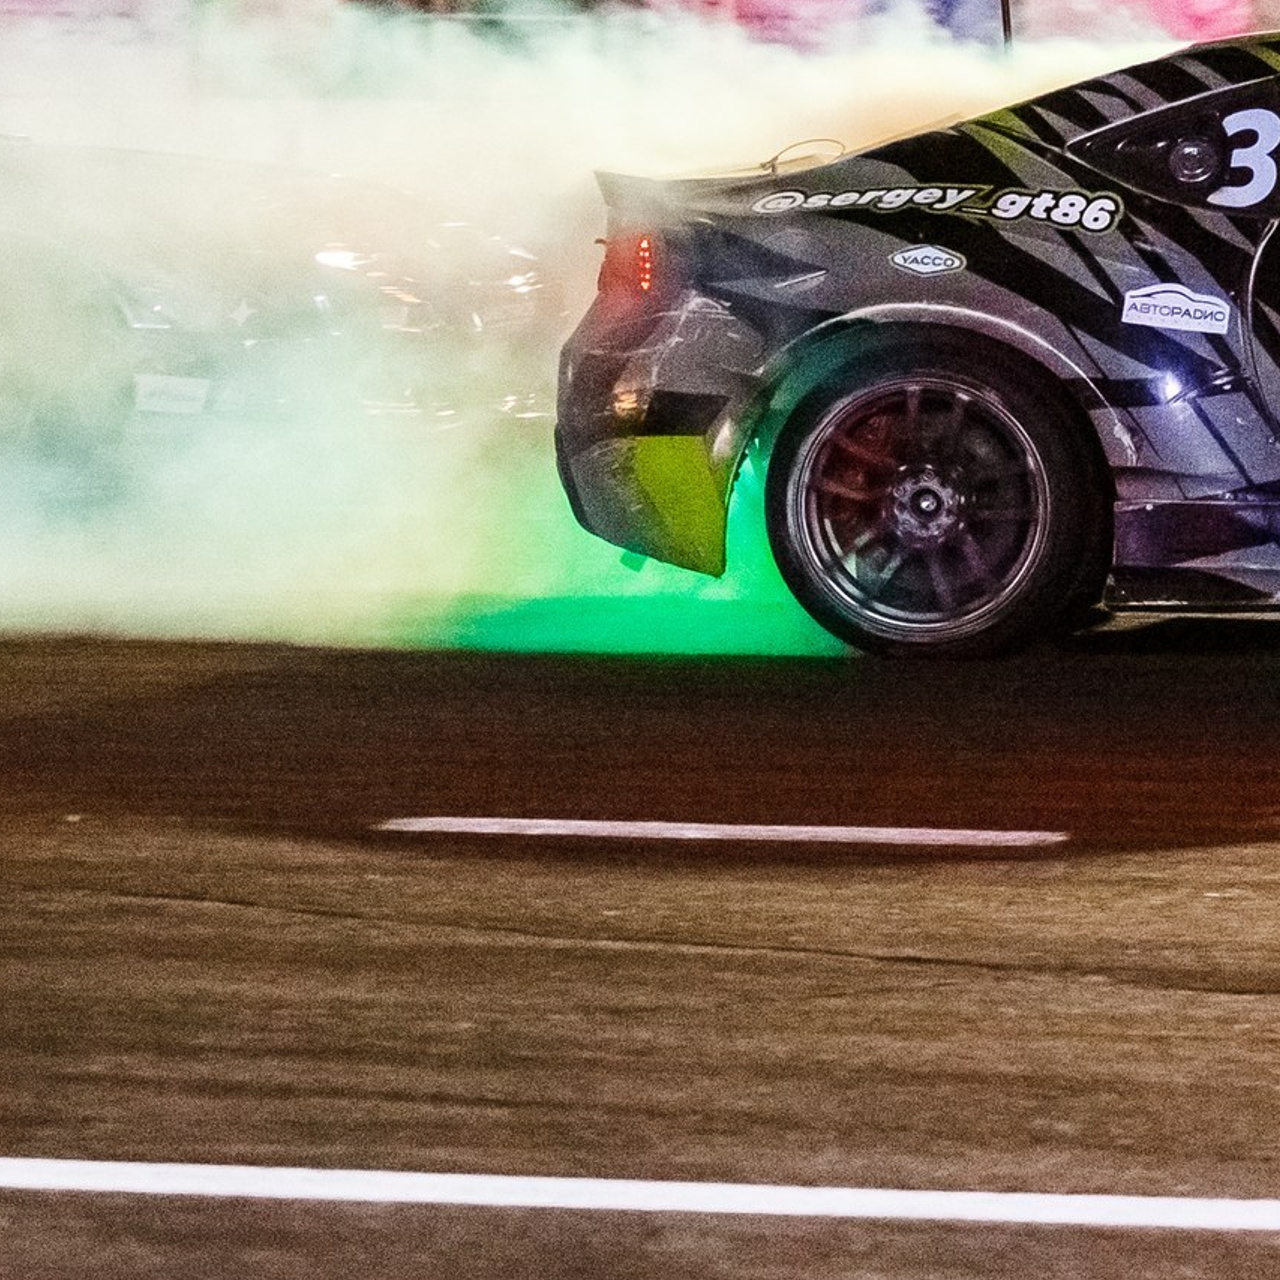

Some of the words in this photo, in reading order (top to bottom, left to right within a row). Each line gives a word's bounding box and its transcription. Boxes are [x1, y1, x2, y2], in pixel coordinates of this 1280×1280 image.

[751, 186, 1118, 230] @sergey_gt86
[900, 254, 956, 268] YACCO
[1127, 301, 1226, 322] АВТОРАДИО
